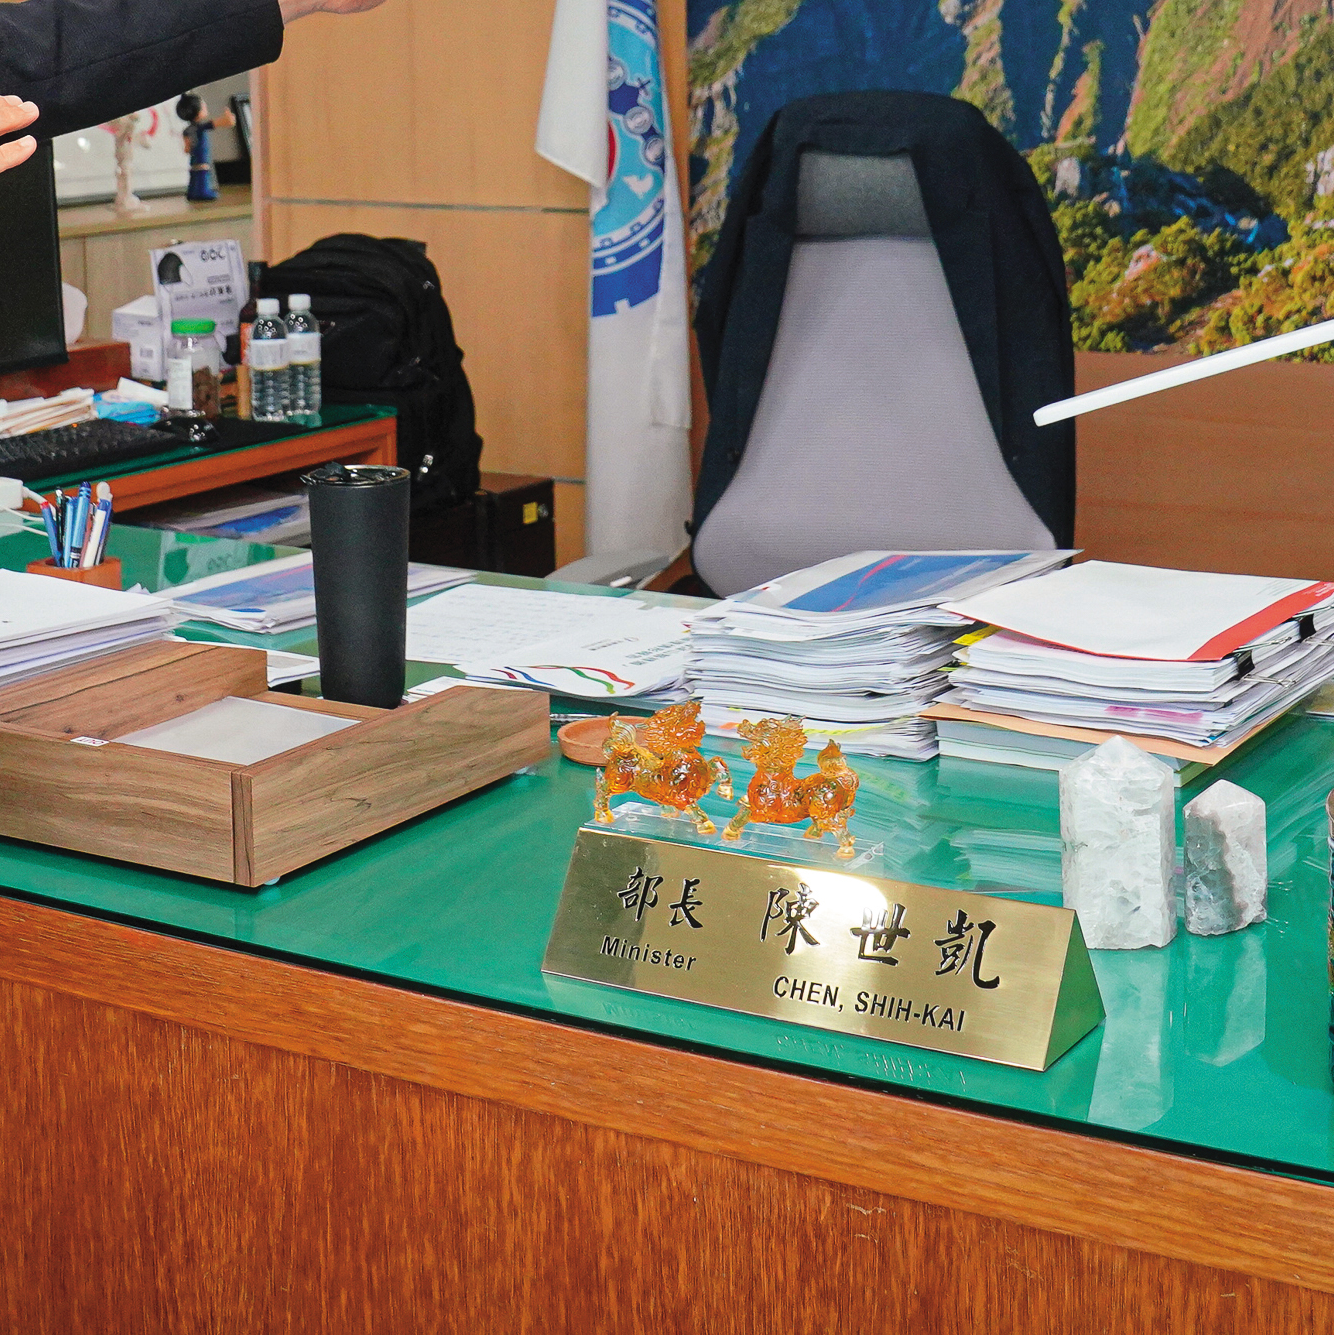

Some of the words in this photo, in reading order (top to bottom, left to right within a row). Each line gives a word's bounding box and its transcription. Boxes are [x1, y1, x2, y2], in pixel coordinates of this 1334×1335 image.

[599, 935, 697, 972] Minister
[616, 866, 704, 930] 部長
[760, 881, 1001, 990] 陳世凱
[773, 975, 844, 1013] CHEN,
[854, 991, 967, 1033] SHIH-KAI
